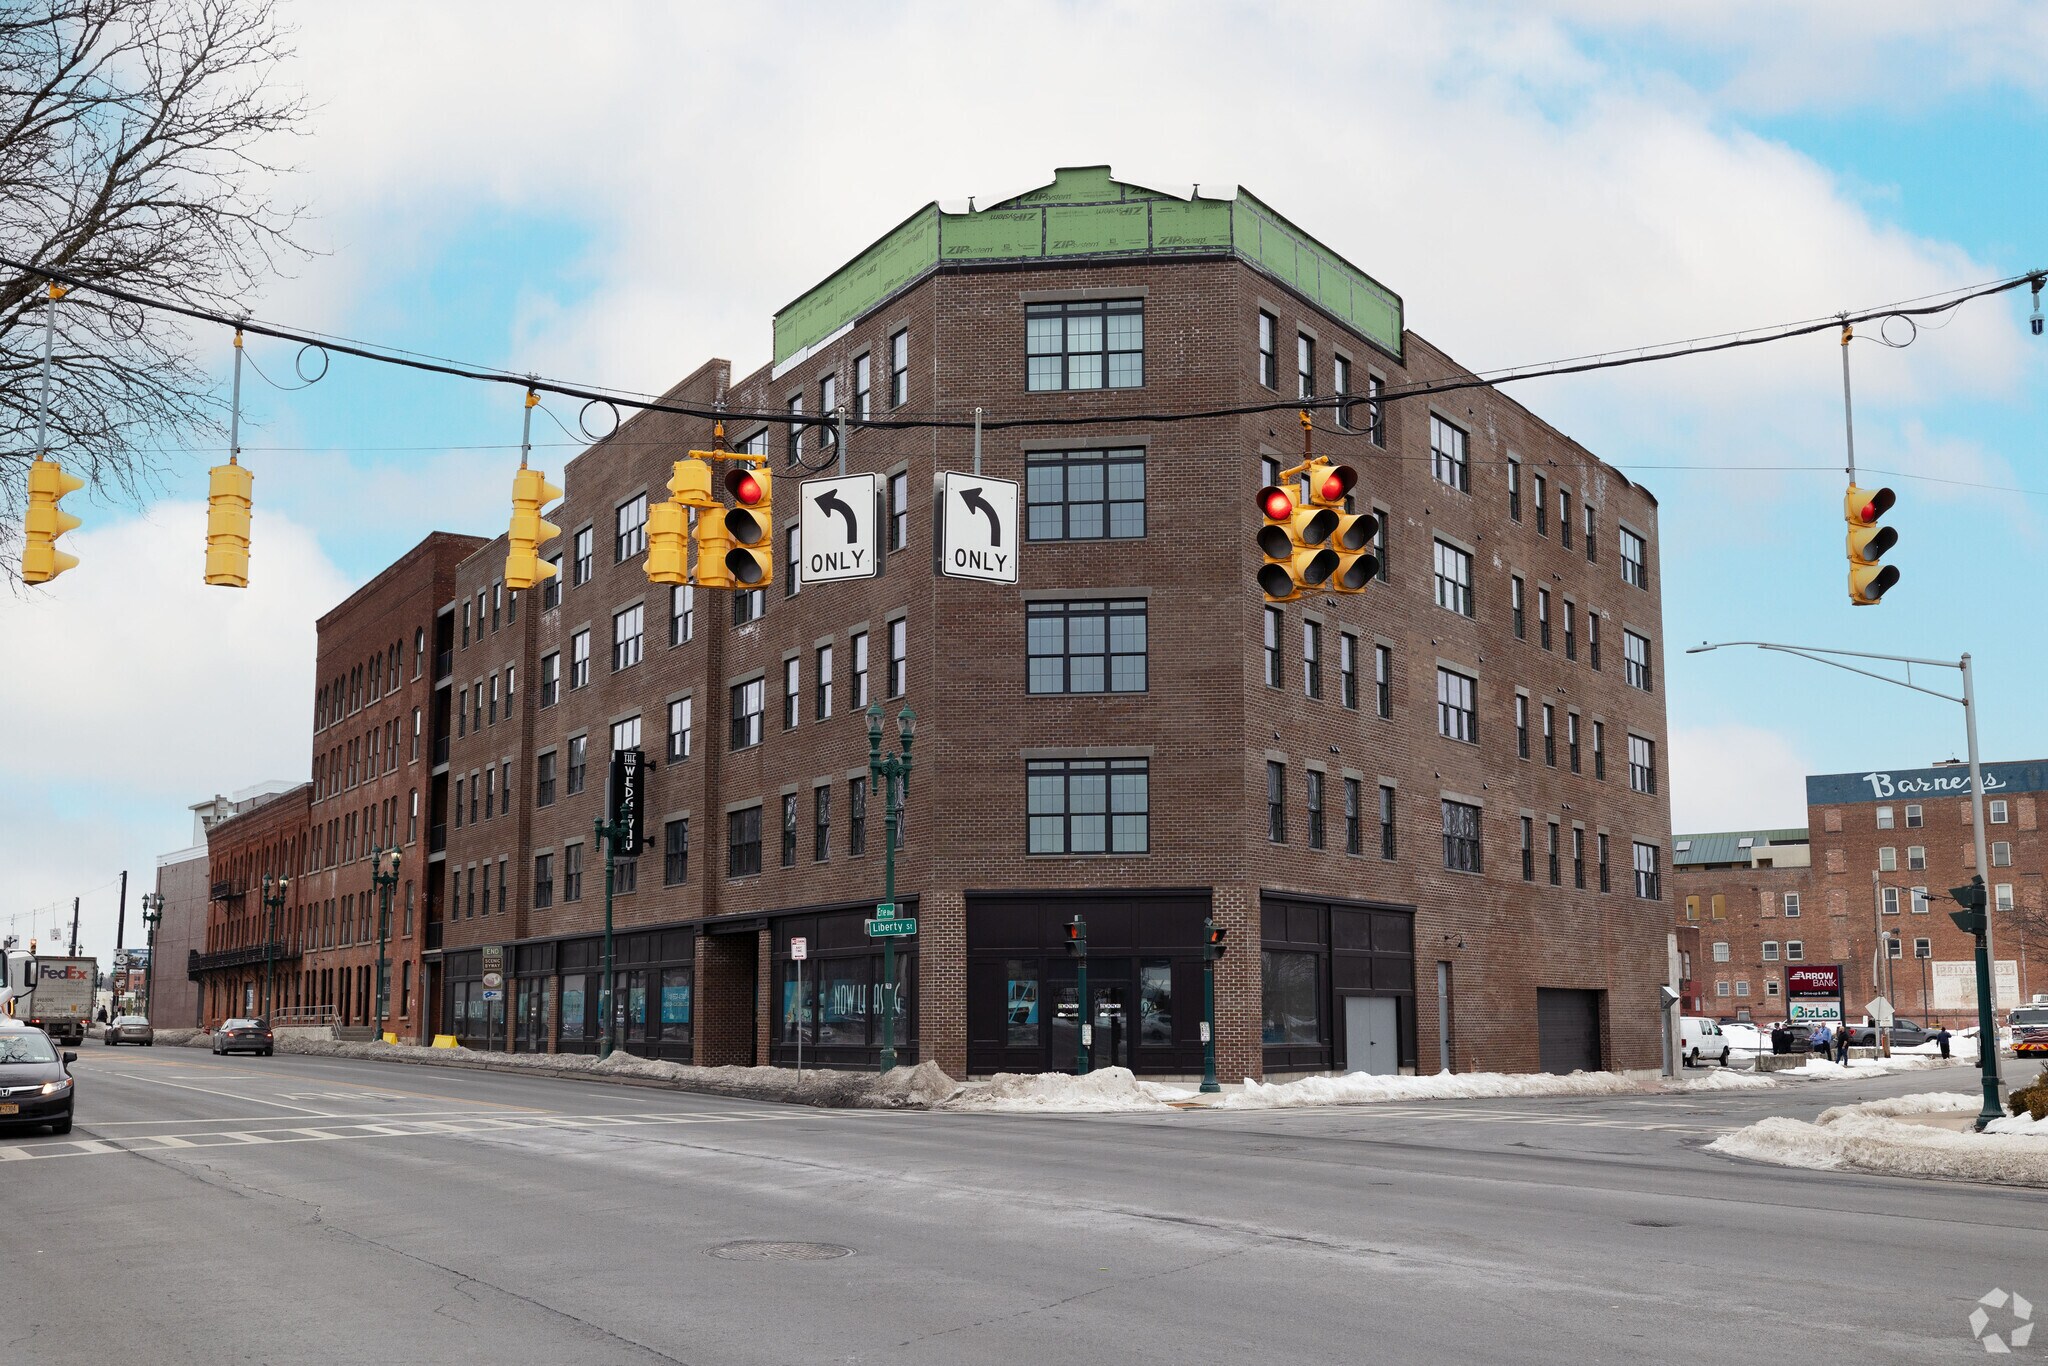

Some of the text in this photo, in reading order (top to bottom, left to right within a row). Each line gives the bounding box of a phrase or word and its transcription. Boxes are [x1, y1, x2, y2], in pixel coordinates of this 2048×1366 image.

[811, 549, 865, 573] ONLY
[955, 548, 1008, 573] ONLY
[624, 753, 637, 764] THE
[872, 922, 903, 933] Liberty
[40, 965, 88, 980] FedEx
[1790, 971, 1834, 980] ARROW
[1813, 979, 1838, 987] BANK
[834, 982, 901, 1015] NOW LEASG
[1796, 1006, 1838, 1018] BizLab
